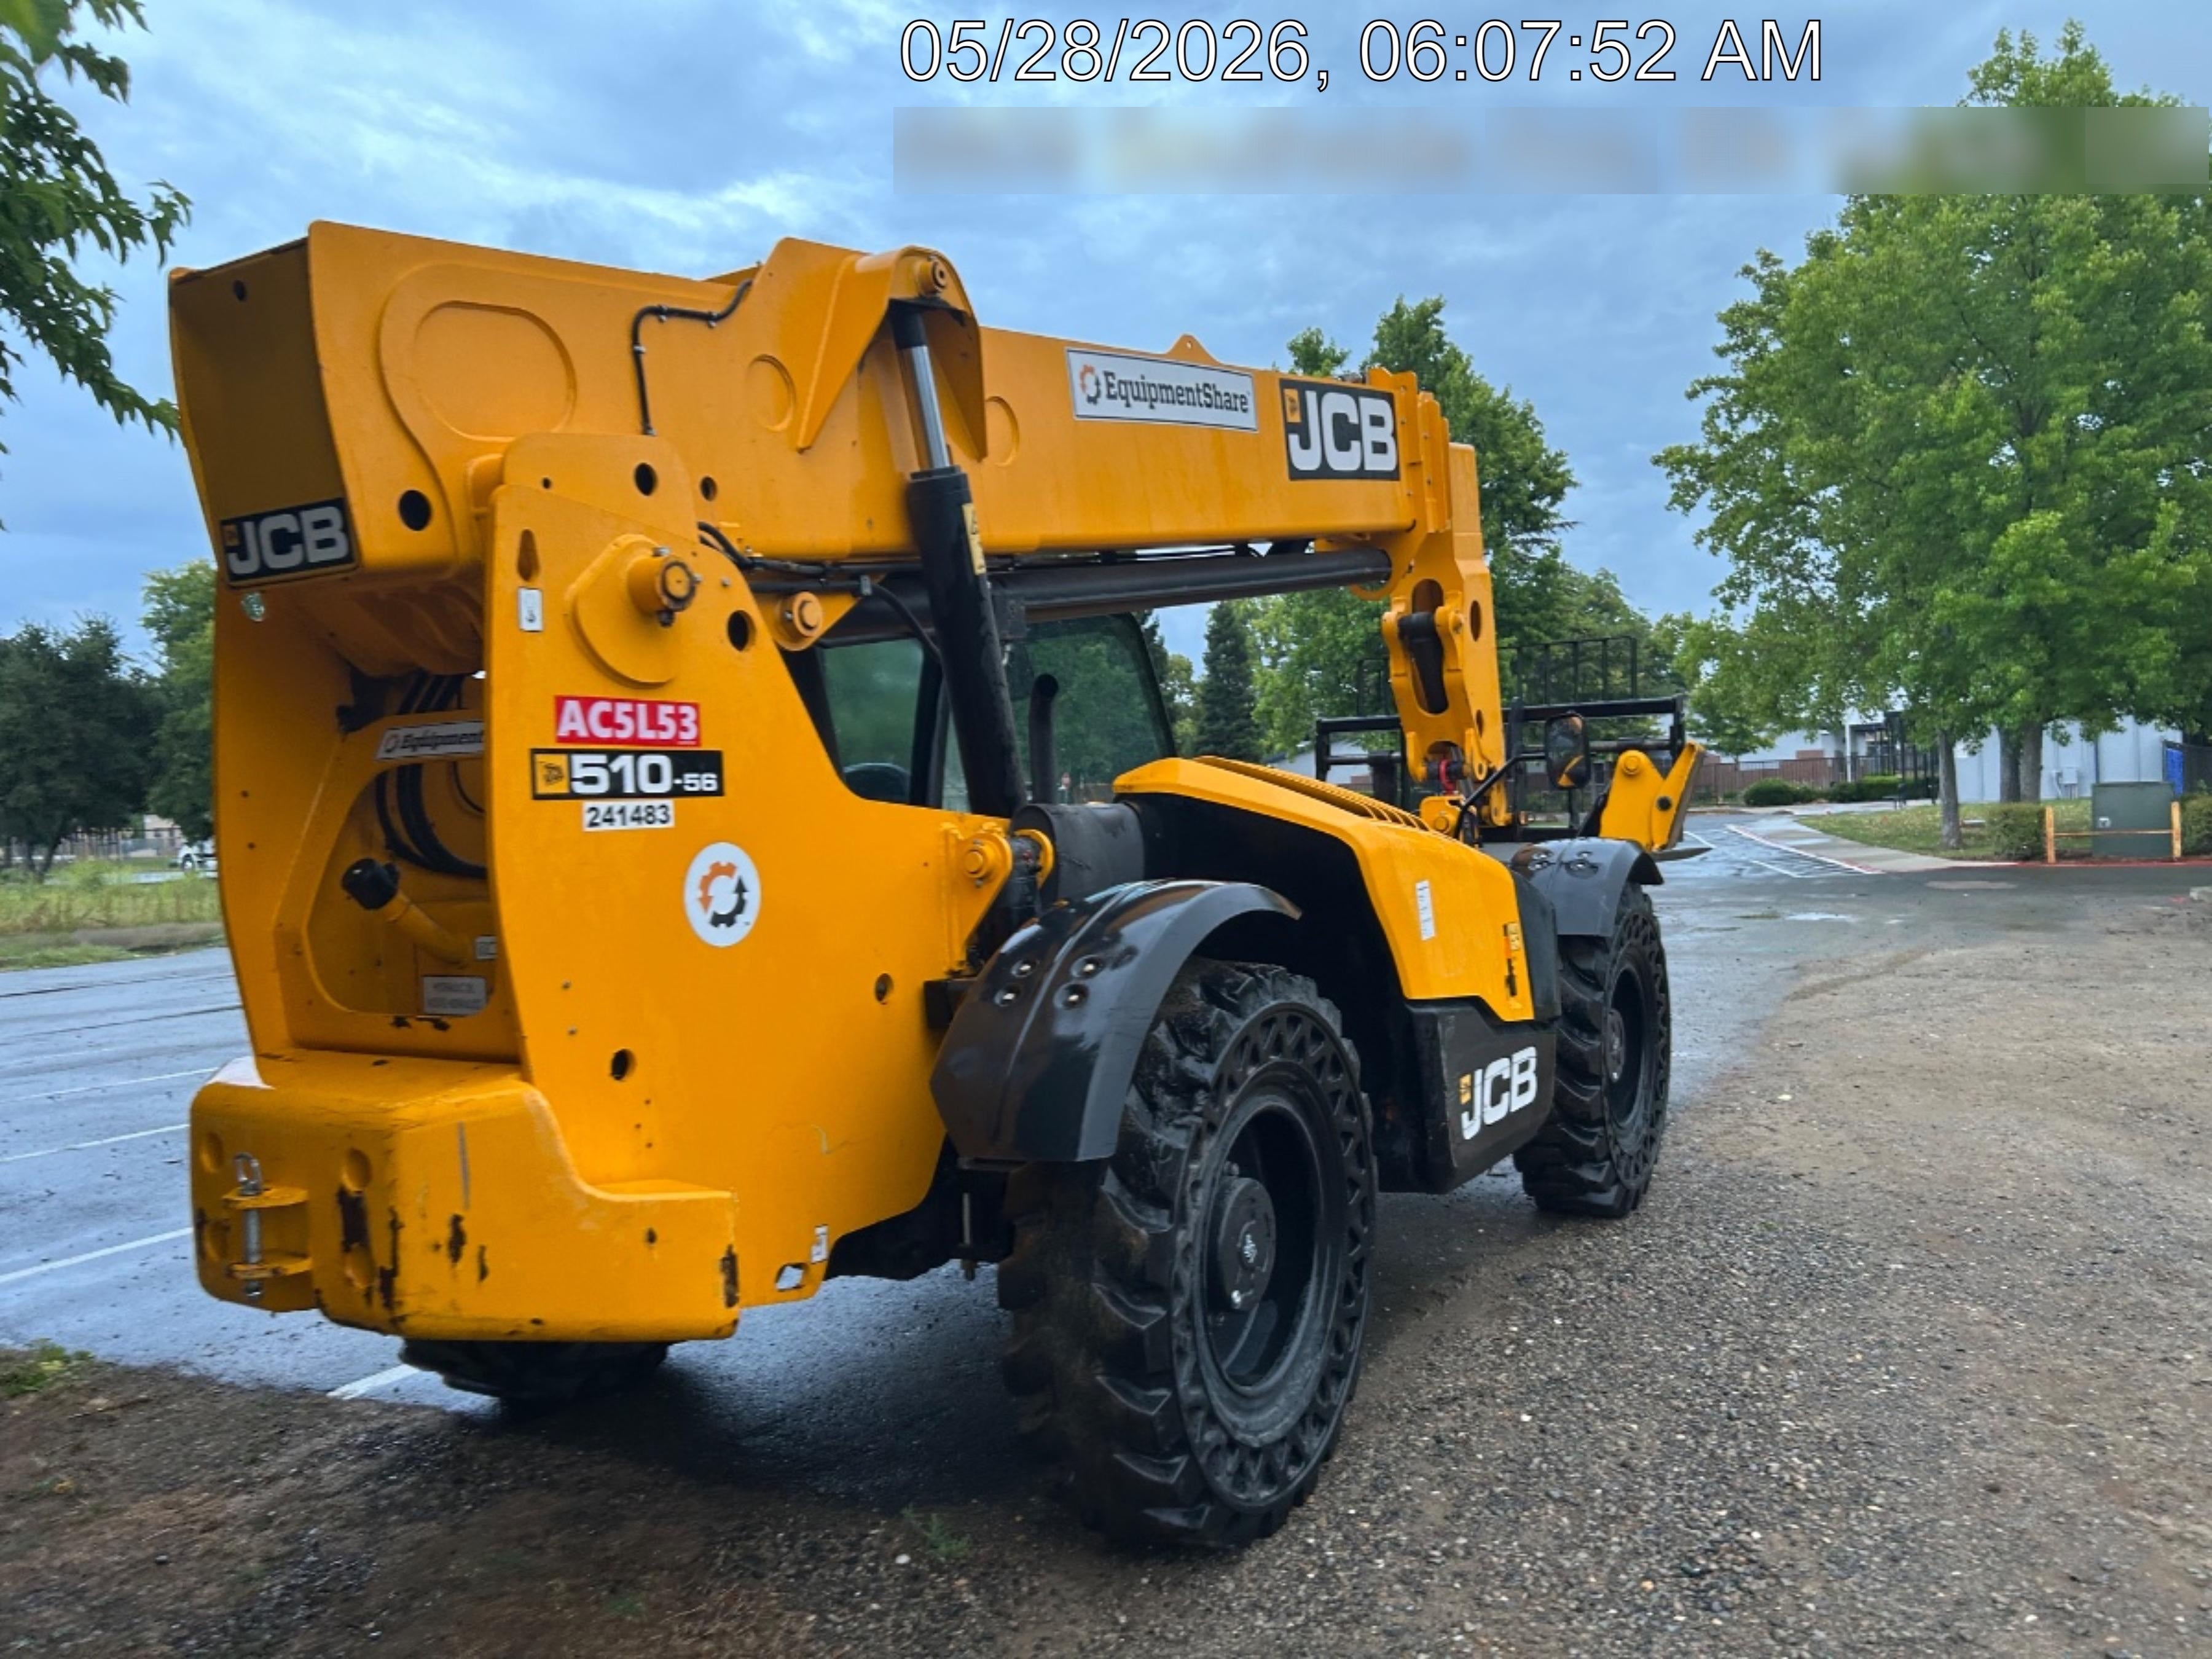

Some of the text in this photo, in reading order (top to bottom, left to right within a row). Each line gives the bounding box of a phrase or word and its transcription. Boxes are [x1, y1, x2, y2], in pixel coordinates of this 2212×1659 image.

[1104, 370, 1249, 414] EquipmentShare
[1288, 390, 1397, 471] JCB
[227, 506, 350, 575] JCB
[557, 699, 698, 742] AC5L53
[586, 804, 670, 828] 241483
[1461, 1046, 1537, 1140] JCB
